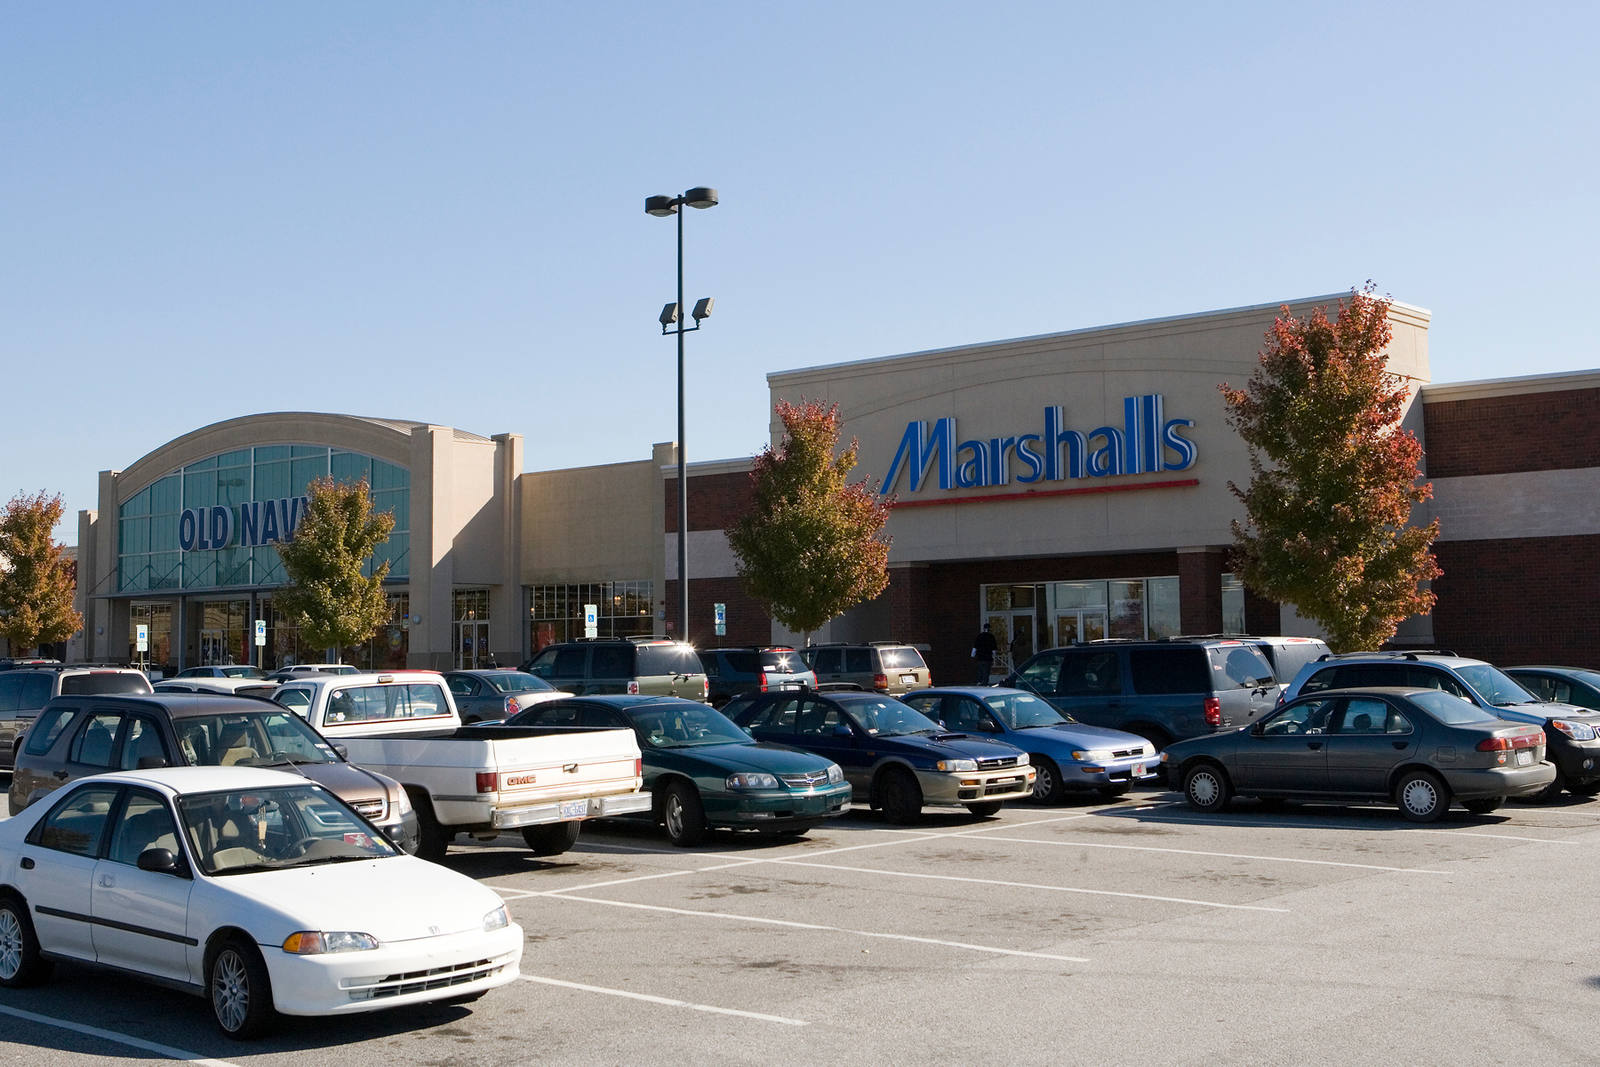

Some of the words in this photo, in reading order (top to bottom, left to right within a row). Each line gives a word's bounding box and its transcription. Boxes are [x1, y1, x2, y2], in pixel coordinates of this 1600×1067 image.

[881, 394, 1199, 495] Marshalls
[179, 505, 233, 552] OLD
[507, 776, 537, 786] GMC
